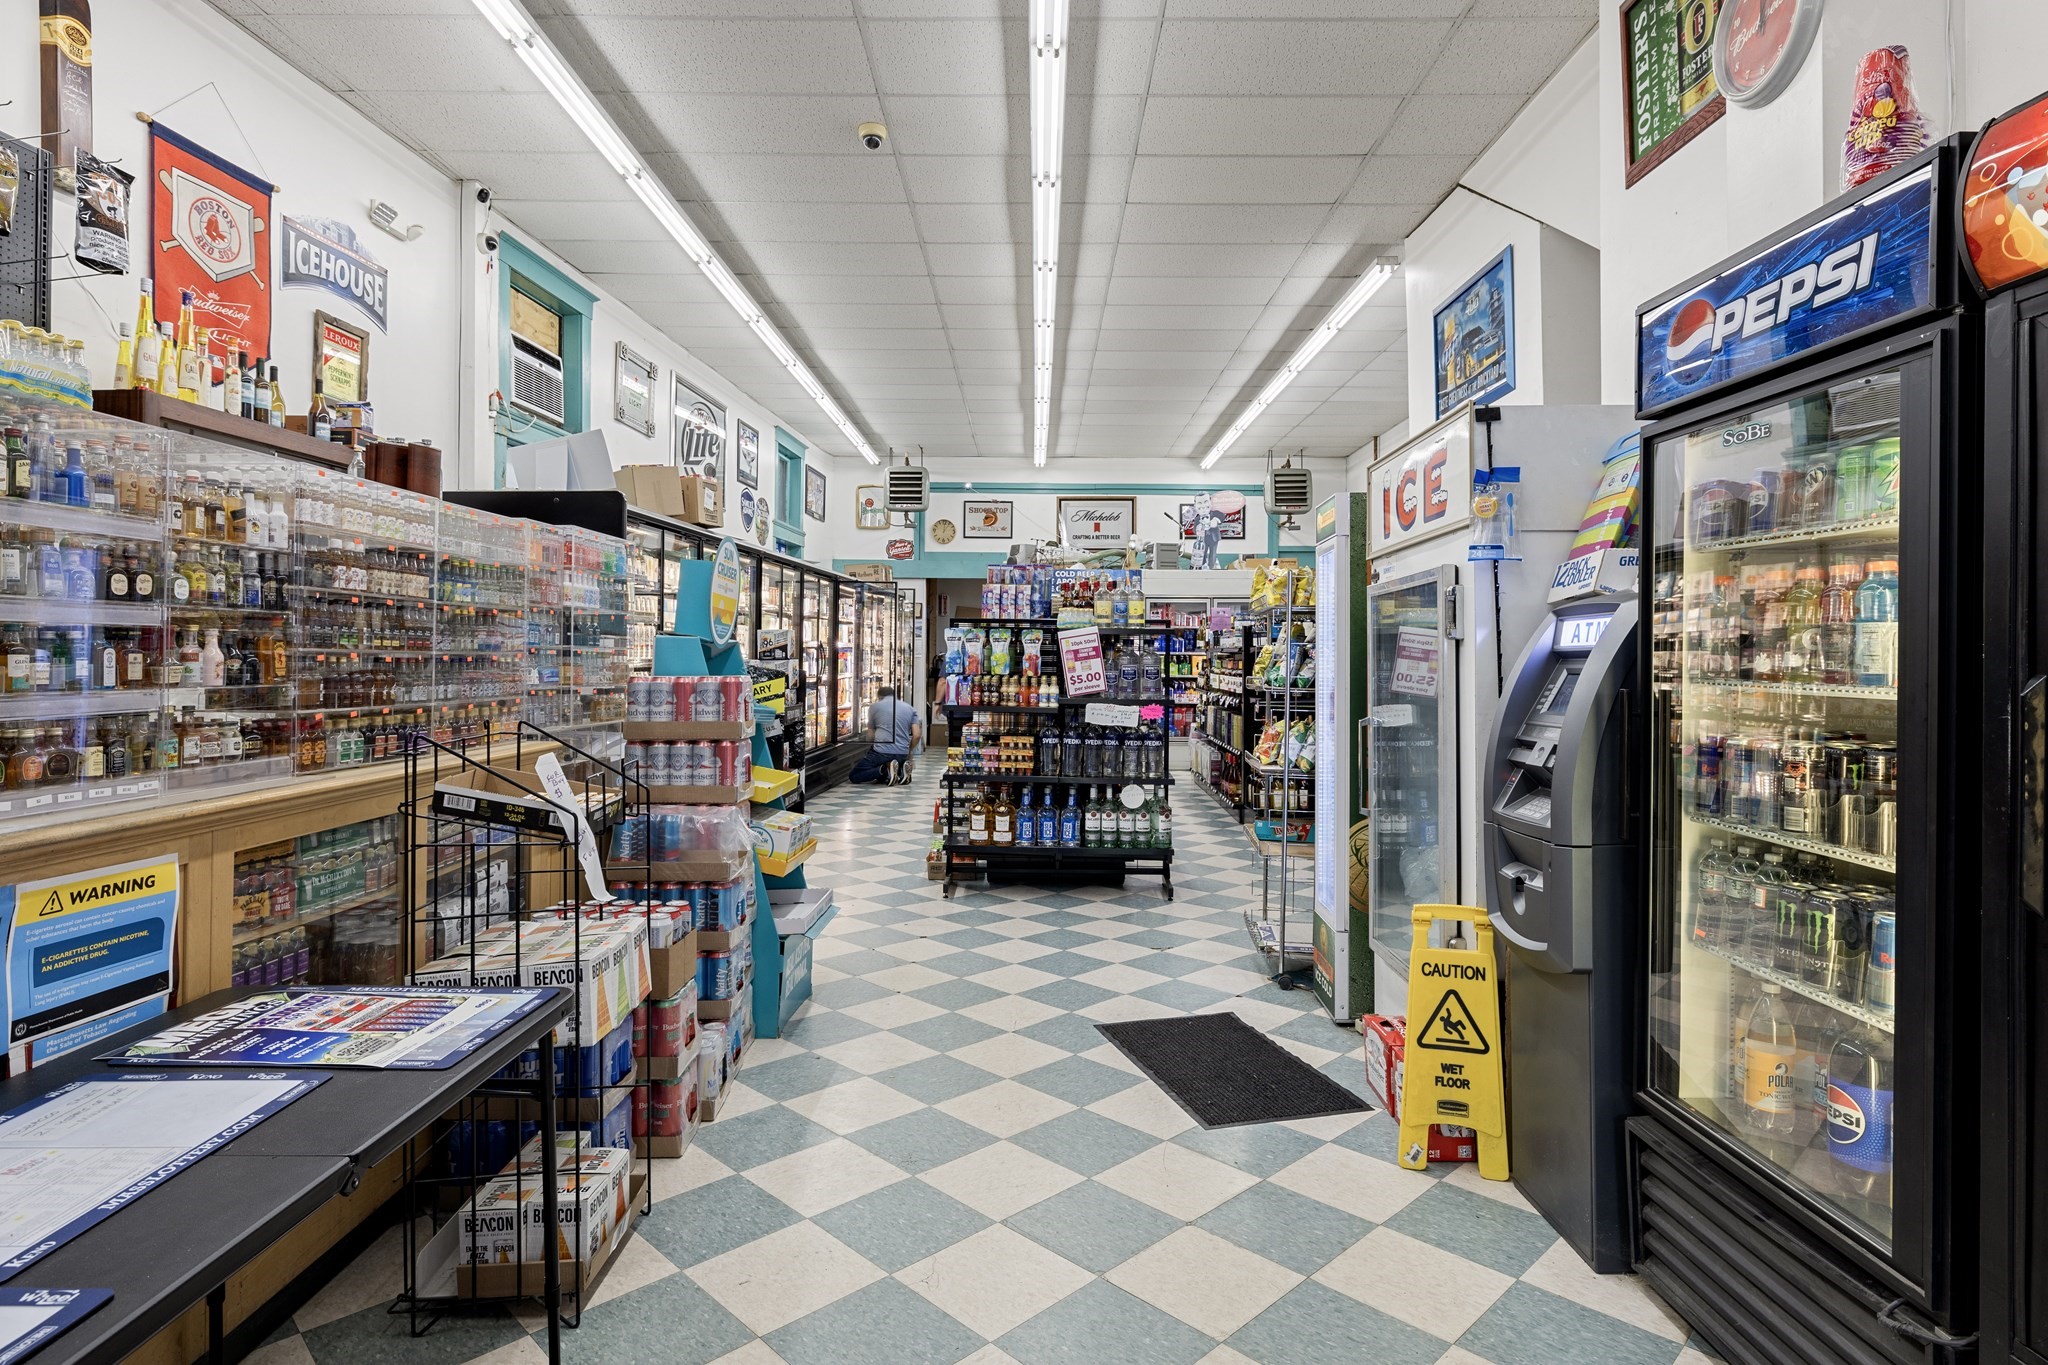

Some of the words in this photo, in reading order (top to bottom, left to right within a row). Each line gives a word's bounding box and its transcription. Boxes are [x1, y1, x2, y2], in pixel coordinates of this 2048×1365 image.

[1733, 18, 1741, 30] 10
[1734, 64, 1739, 73] 8
[1745, 70, 1750, 81] 7
[1759, 65, 1765, 76] 6
[1633, 10, 1653, 155] FOSTER'S
[1651, 46, 1663, 142] PREMIUM
[193, 201, 236, 230] BOSTON
[195, 235, 215, 256] RED
[218, 249, 236, 261] SOX
[288, 230, 384, 317] ICEHOUSE
[1711, 231, 1879, 352] PEPSI
[325, 329, 360, 351] LEROUX
[10, 361, 53, 380] Natural
[328, 364, 354, 382] PEPPERMINT
[1438, 395, 1449, 411] TASTE
[1477, 366, 1500, 388] BRICKYARD
[683, 428, 720, 467] Lite
[1382, 443, 1448, 540] ICE
[1070, 509, 1121, 523] Michelob
[723, 547, 734, 560] SUN
[1568, 556, 1592, 572] PACK
[717, 563, 737, 580] CRUISER
[1551, 562, 1569, 588] 12
[1566, 565, 1596, 588] COOLER
[753, 684, 772, 697] ARY
[1069, 671, 1102, 686] $5.00
[620, 830, 632, 859] Natty
[69, 875, 156, 905] WARNING
[55, 918, 73, 930] aerosol
[695, 898, 707, 929] Natty
[41, 946, 88, 964] E-CIGARETTES
[89, 938, 119, 951] CONTAIN
[119, 929, 149, 943] NICOTINE,
[41, 964, 53, 973] AN
[54, 956, 89, 970] ADDICTIVE
[89, 949, 109, 960] DRUG.
[592, 954, 610, 980] BEACON
[1421, 962, 1486, 981] CAUTION
[714, 966, 728, 998] Natty
[1315, 969, 1323, 986] ICE
[1322, 976, 1333, 998] COLD
[46, 1026, 94, 1047] Massachusetts
[94, 1022, 108, 1031] Law
[108, 1010, 137, 1026] Regarding
[46, 1044, 58, 1054] the
[59, 1039, 74, 1050] Sale
[74, 1036, 82, 1045] of
[82, 1026, 108, 1042] Tobacco
[187, 1072, 223, 1080] KENO
[1440, 1062, 1464, 1076] WET
[1435, 1075, 1471, 1091] FLOOR
[1768, 1075, 1794, 1089] POLAR
[1827, 1105, 1861, 1130] EPSI
[98, 1112, 265, 1212] MASSLOTTERY.COM
[465, 1216, 514, 1233] BEACON
[2, 1240, 57, 1269] KENO
[19, 1289, 80, 1305] Wheel
